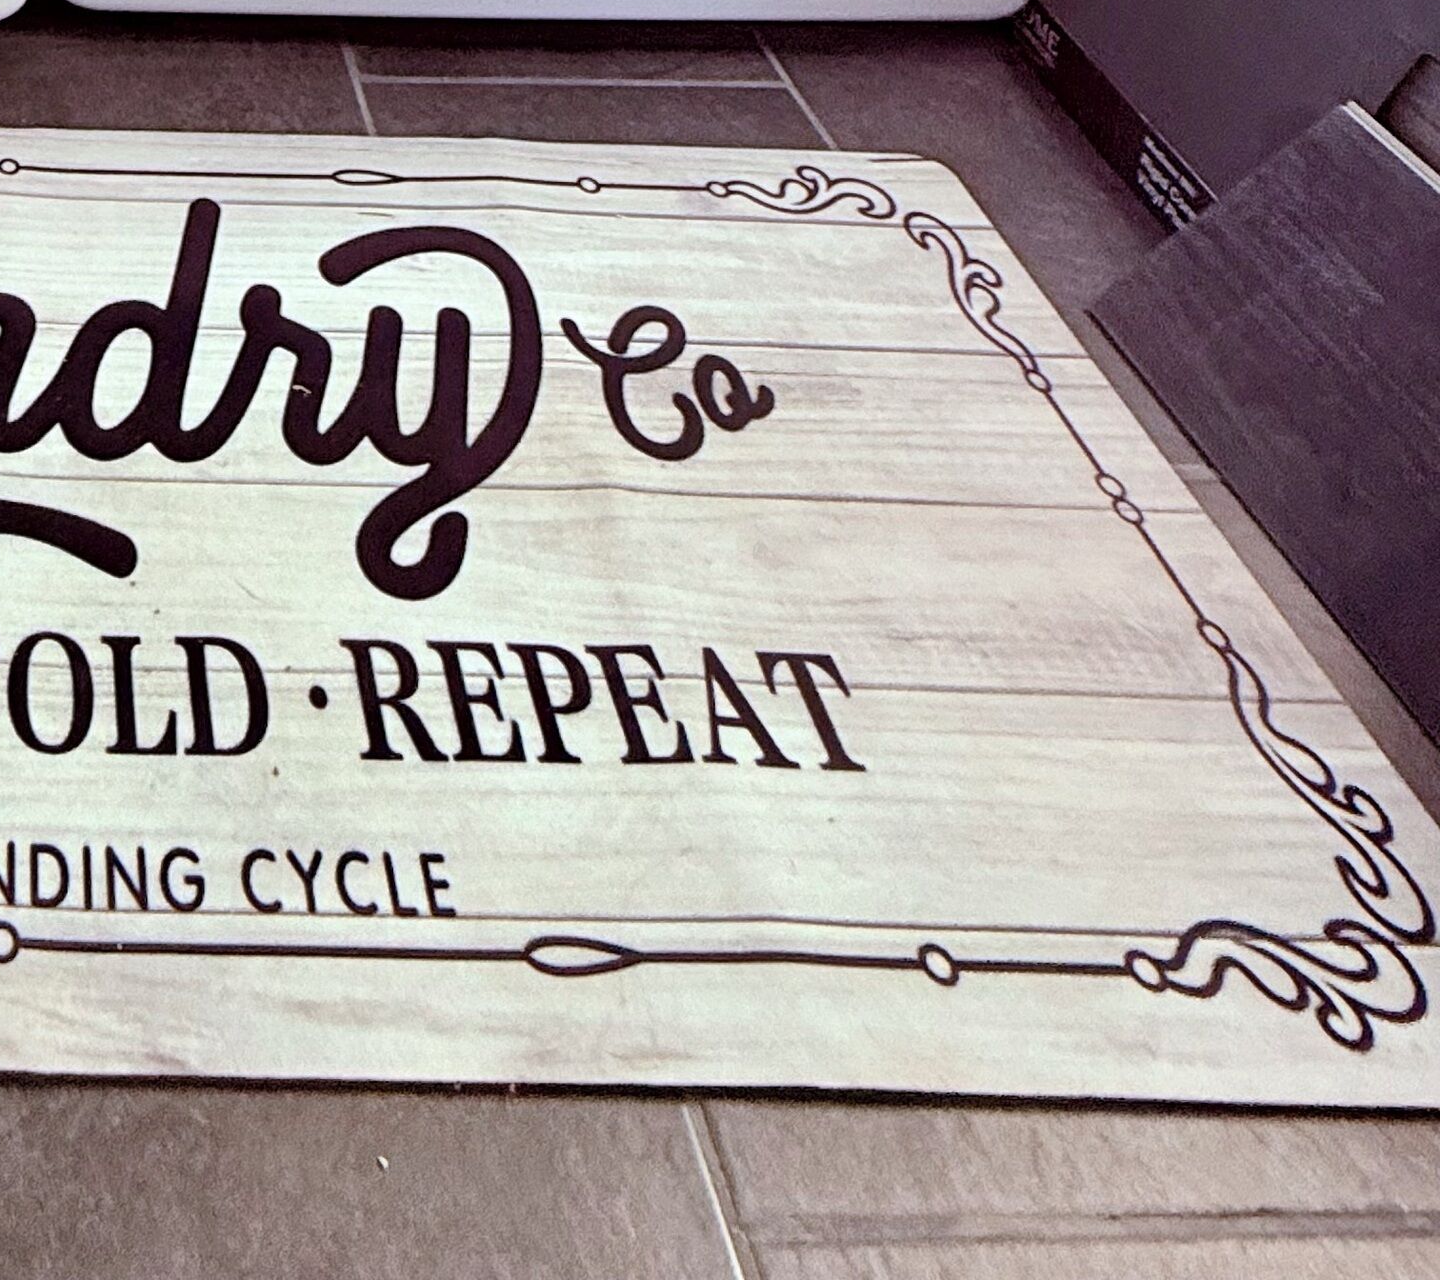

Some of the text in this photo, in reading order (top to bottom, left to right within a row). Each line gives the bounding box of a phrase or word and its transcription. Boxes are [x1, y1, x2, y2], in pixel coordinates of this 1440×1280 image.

[562, 304, 777, 462] Co
[339, 637, 868, 773] REPEAT
[241, 848, 458, 918] CYCLE
